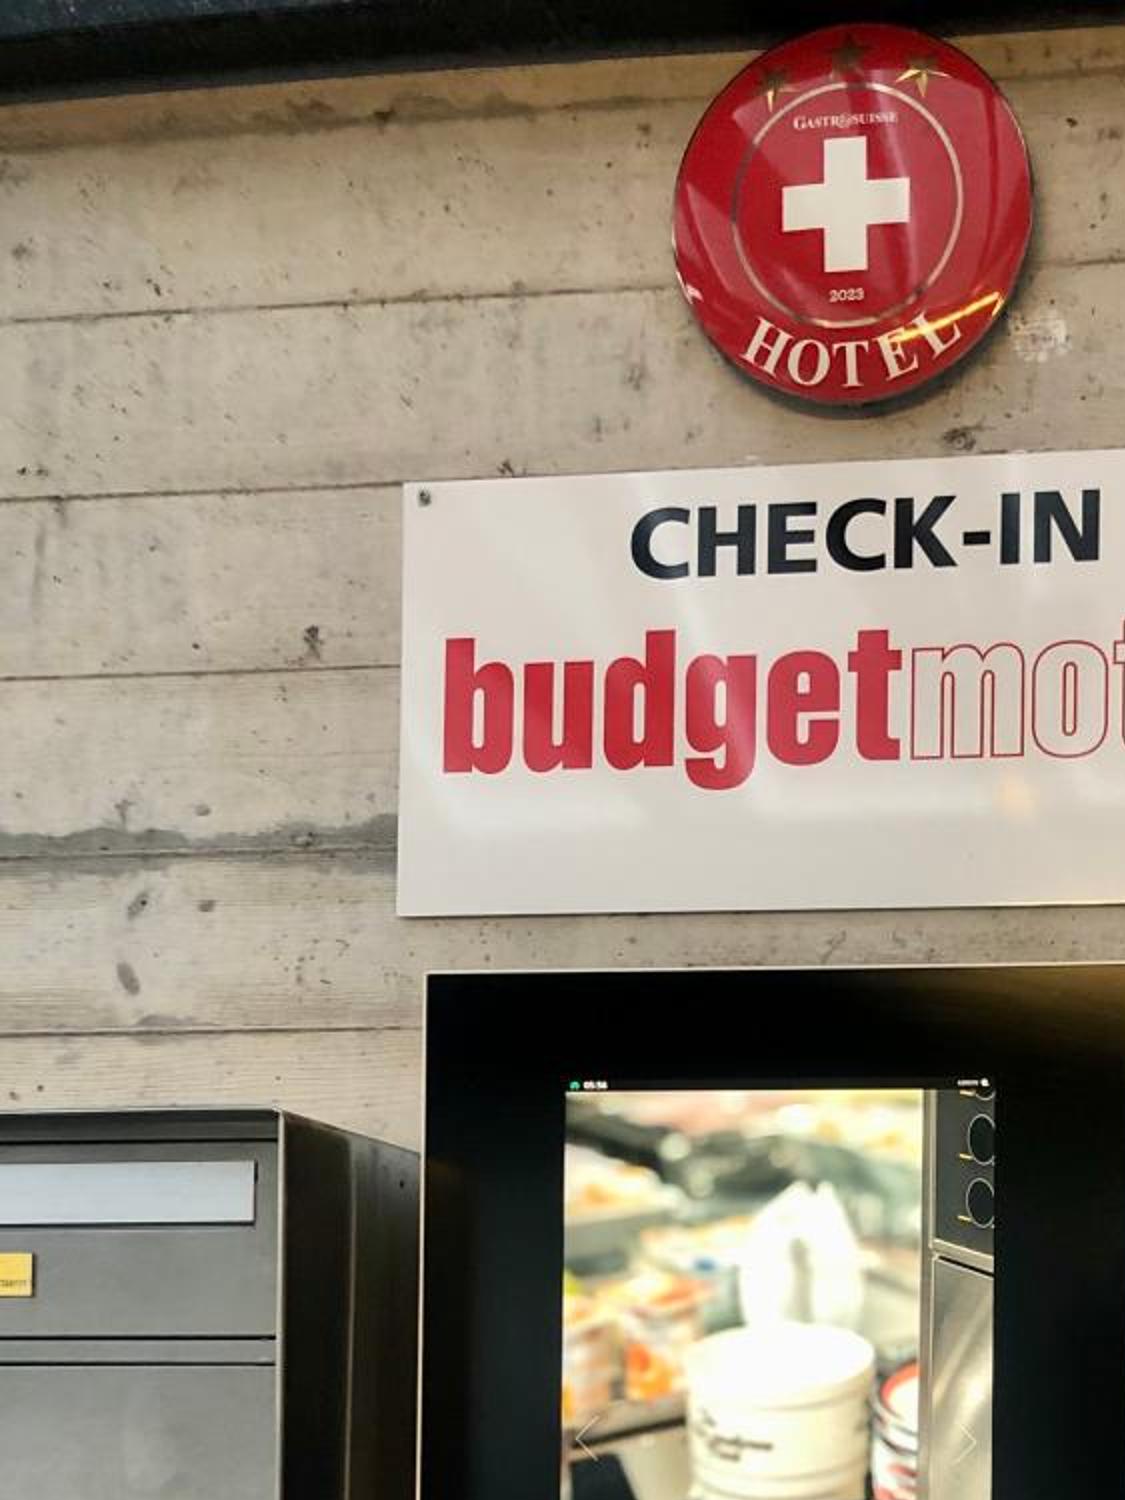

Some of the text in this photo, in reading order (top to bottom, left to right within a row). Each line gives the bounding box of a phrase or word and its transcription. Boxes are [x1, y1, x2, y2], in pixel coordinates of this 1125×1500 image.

[829, 287, 864, 302] 2023
[740, 311, 961, 387] HOTEL
[630, 489, 1102, 579] CHECK-IN
